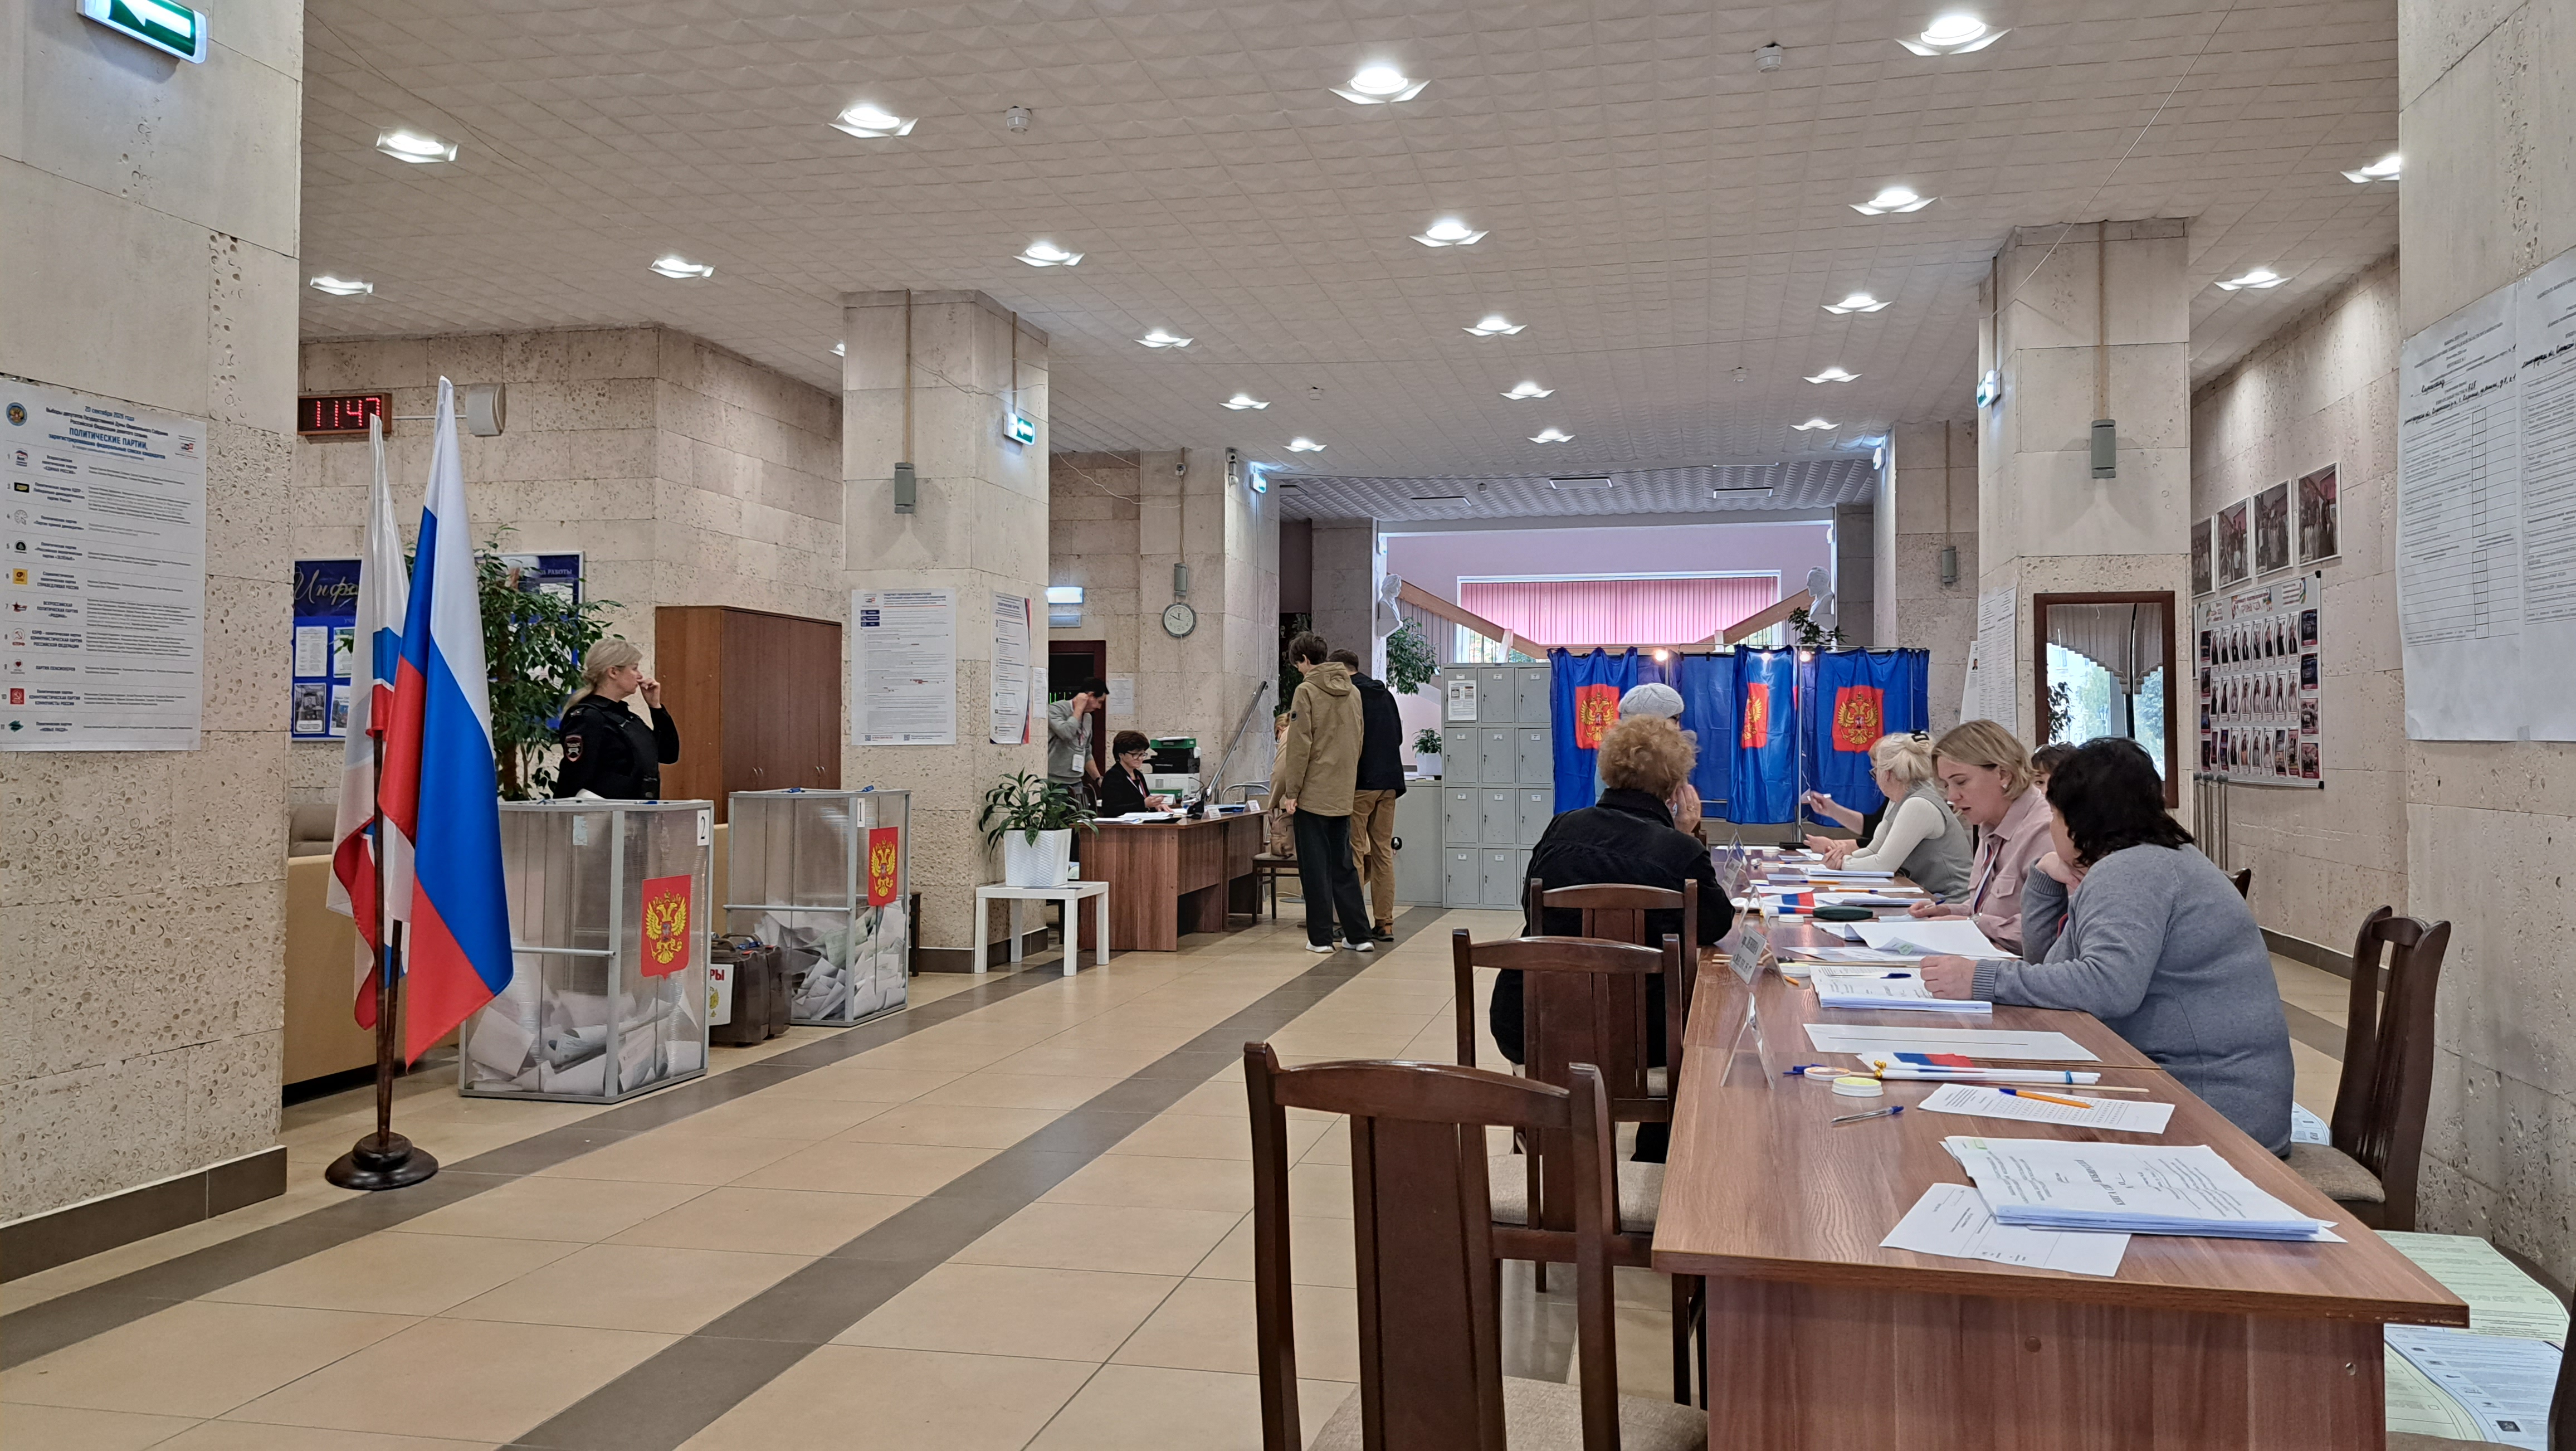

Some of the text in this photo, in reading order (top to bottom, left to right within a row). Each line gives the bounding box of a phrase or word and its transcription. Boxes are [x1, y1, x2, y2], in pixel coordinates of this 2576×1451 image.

[70, 427, 120, 445] ПОЛИТИЧЕСКИЕ
[123, 438, 148, 450] ПАРТИИ,
[294, 566, 358, 606] Инфо
[858, 802, 862, 822] 1
[700, 816, 705, 840] 2
